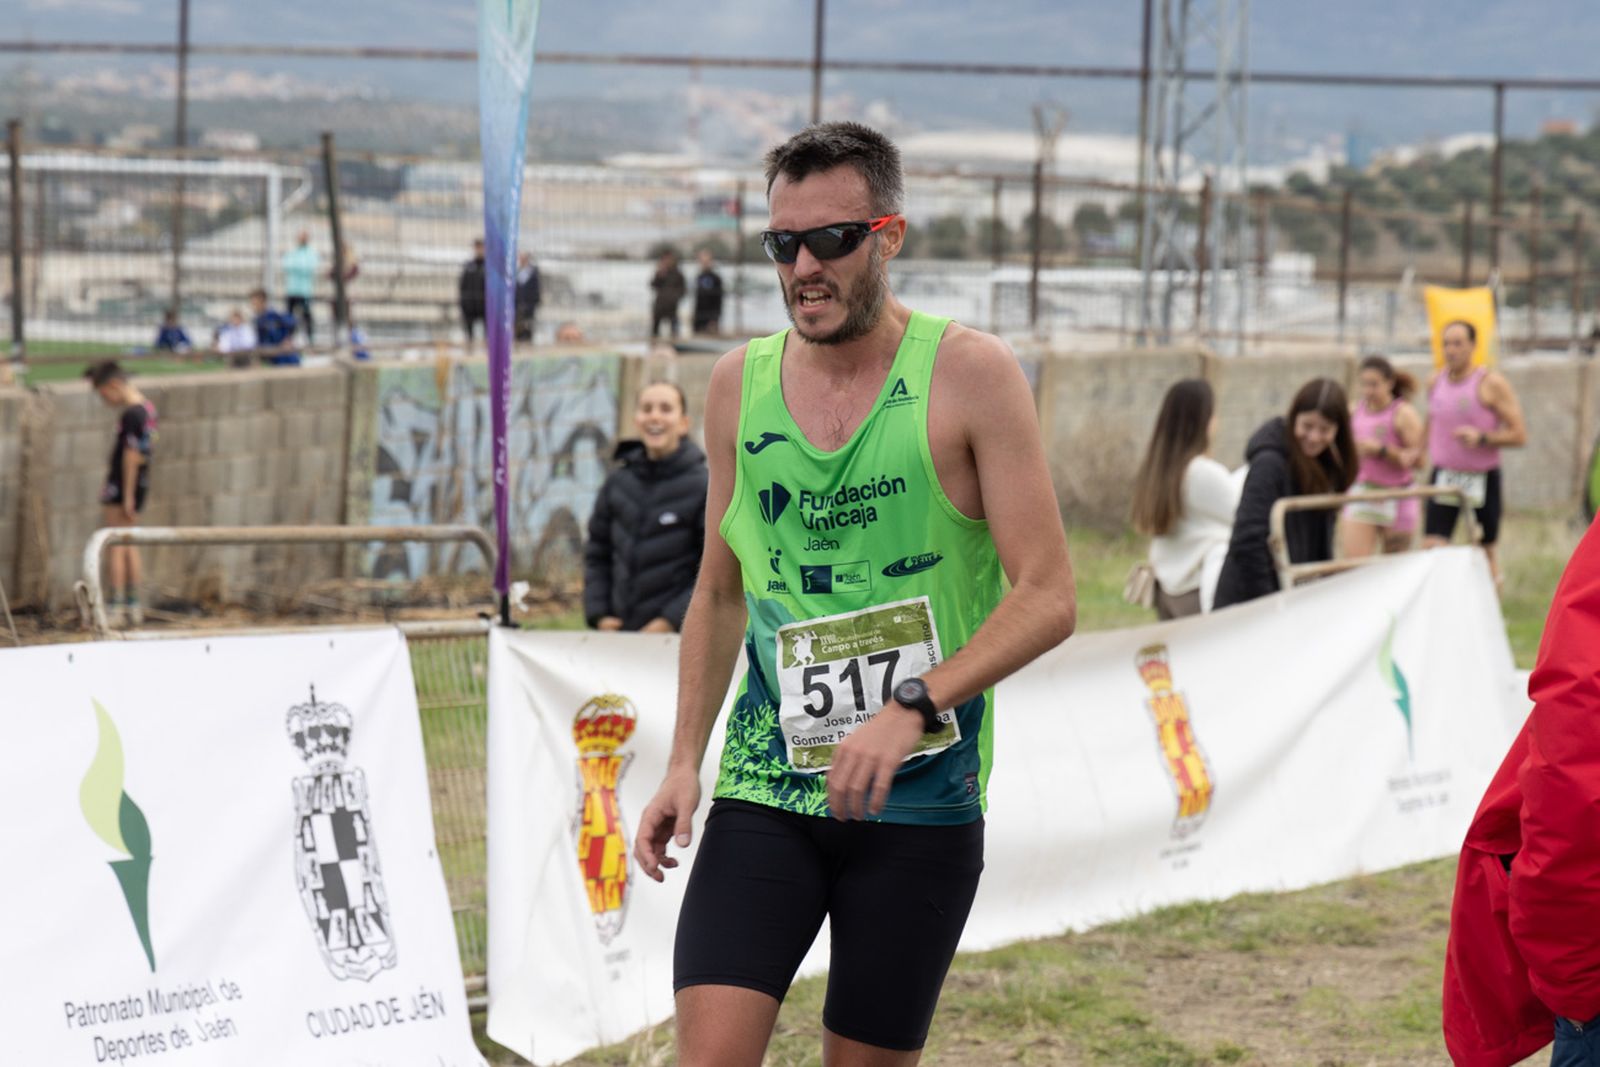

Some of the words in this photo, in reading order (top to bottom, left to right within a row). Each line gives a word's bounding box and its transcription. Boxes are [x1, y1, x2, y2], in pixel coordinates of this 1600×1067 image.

[799, 475, 906, 512] Fundación
[800, 503, 878, 532] Unicaja
[803, 537, 840, 552] Jaén
[821, 642, 851, 654] Campo
[852, 641, 859, 649] a
[859, 634, 884, 647] través
[922, 623, 937, 669] asculino
[802, 649, 901, 718] 517
[824, 713, 853, 729] Jose
[792, 734, 834, 747] Gomez
[64, 994, 145, 1028] Patronato
[148, 981, 217, 1016] Municipal
[219, 978, 243, 1001] de
[306, 1004, 376, 1038] CIUDAD
[381, 997, 405, 1025] DE
[93, 1030, 168, 1066] Deportes
[171, 1023, 193, 1050] de
[196, 1013, 239, 1049] Jaén
